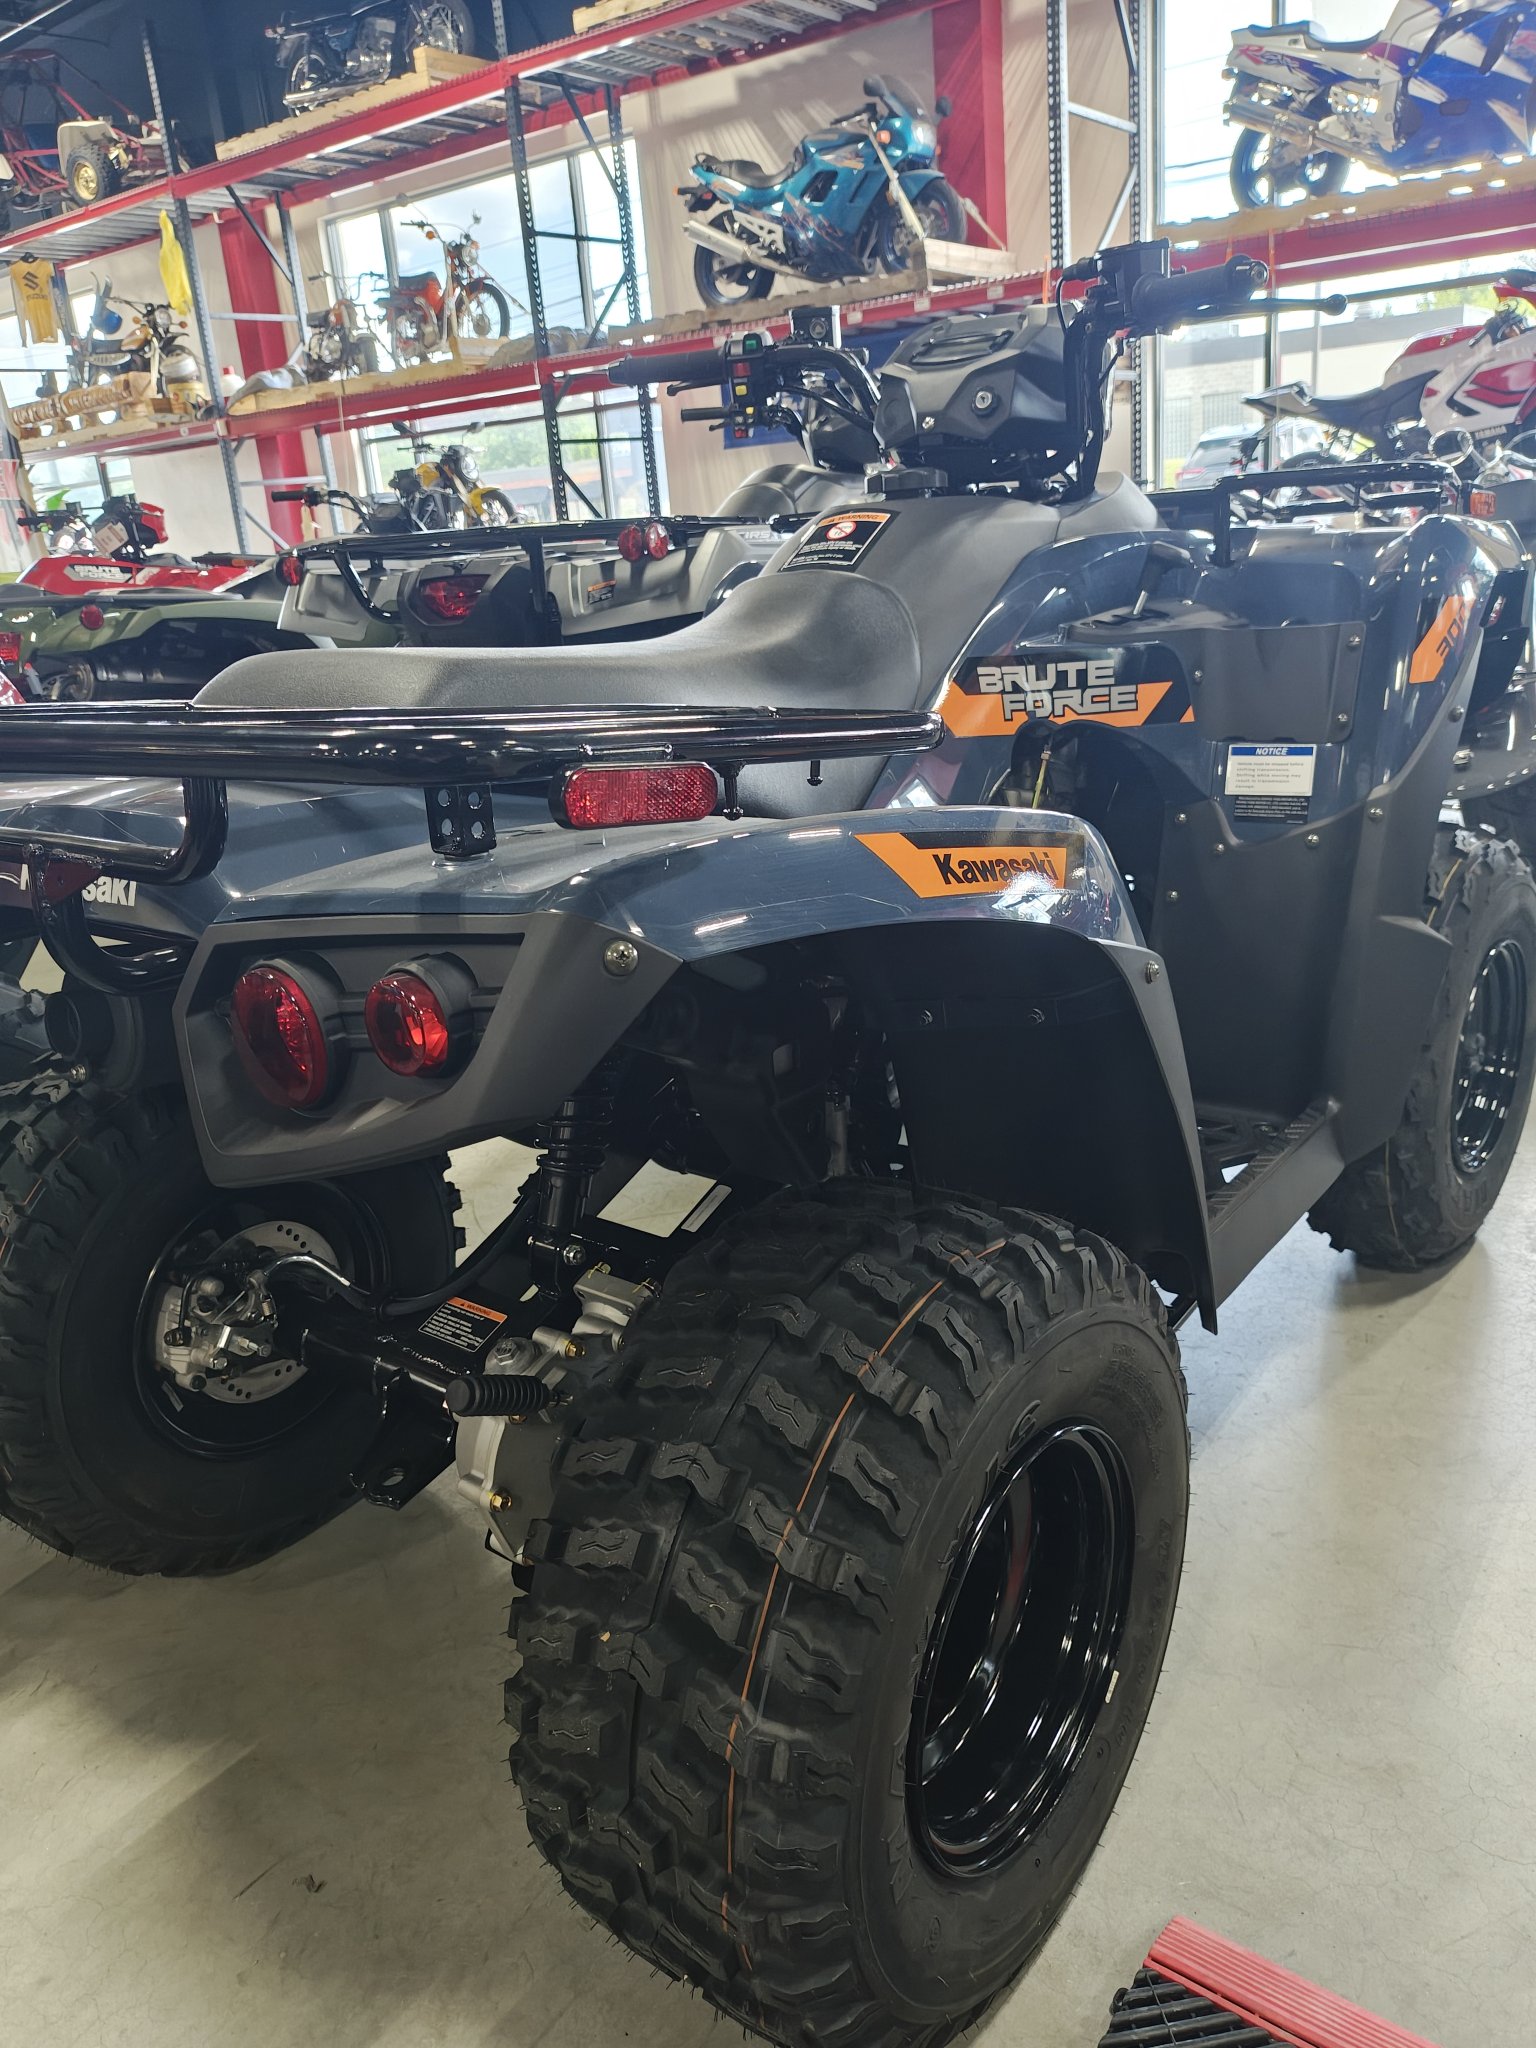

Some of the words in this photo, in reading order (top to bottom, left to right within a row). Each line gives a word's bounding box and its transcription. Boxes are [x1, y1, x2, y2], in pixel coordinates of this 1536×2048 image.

[977, 659, 1115, 693] BRUTE
[1003, 684, 1138, 720] FORCE
[1255, 747, 1289, 755] NOTICE
[932, 851, 1059, 885] Kawasaki
